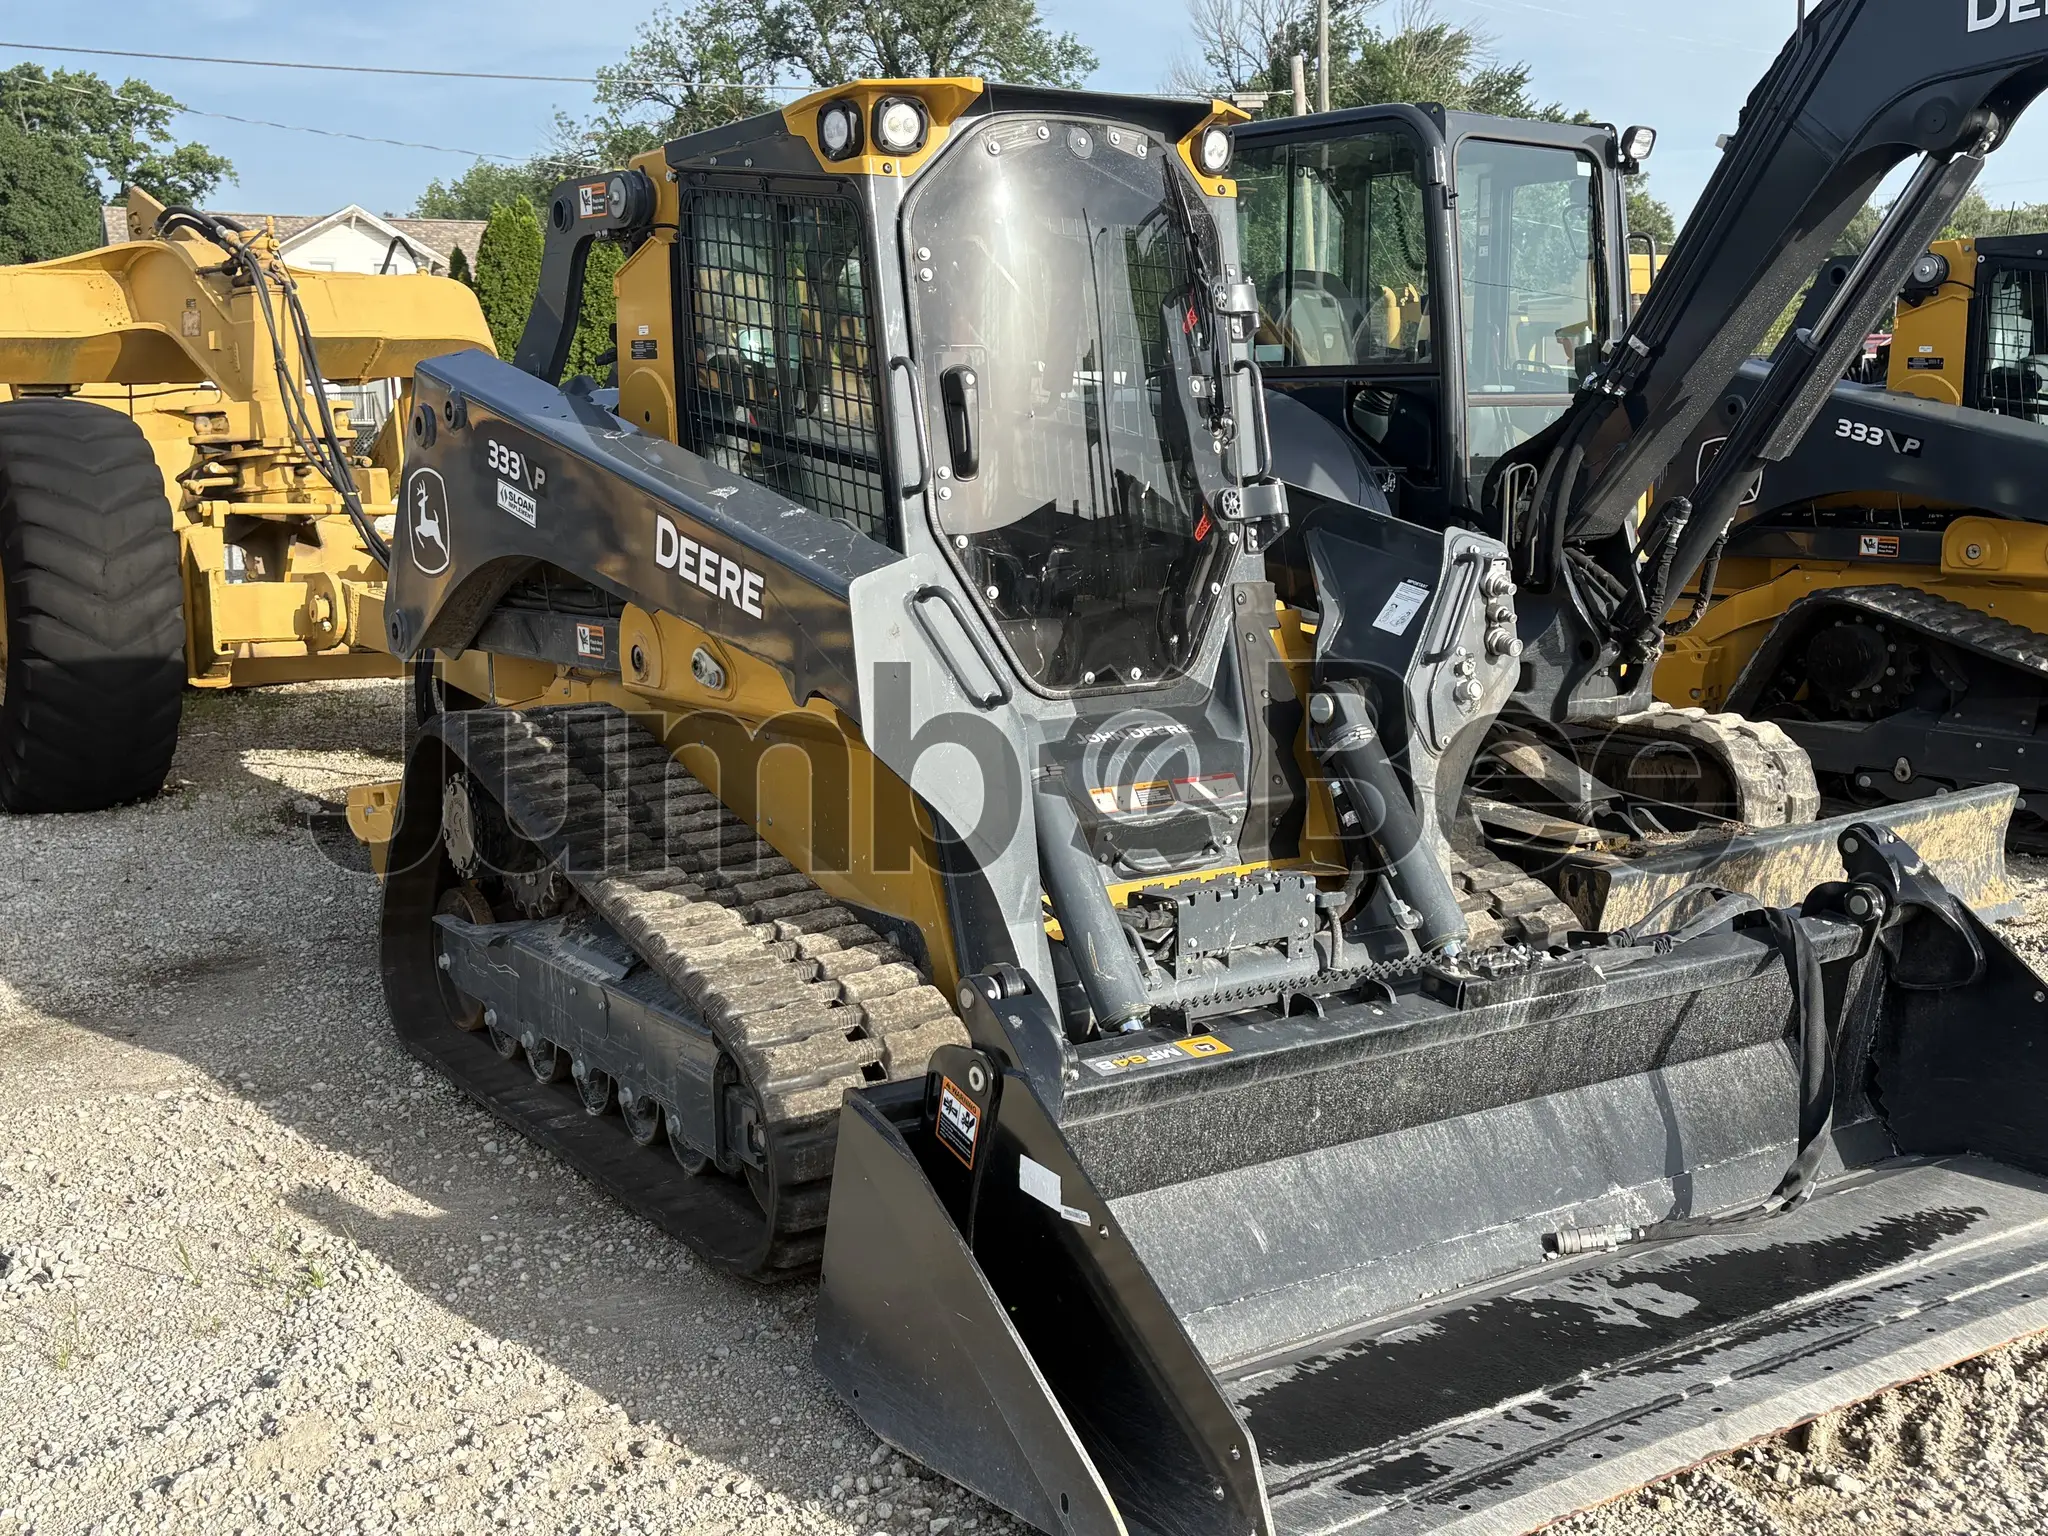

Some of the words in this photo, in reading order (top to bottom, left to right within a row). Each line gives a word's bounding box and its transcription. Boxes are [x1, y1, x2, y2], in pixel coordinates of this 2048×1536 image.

[1967, 0, 2048, 33] DE
[508, 491, 534, 513] SLOAN
[655, 514, 764, 620] DEERE
[1077, 728, 1127, 745] JOHN
[1128, 724, 1193, 740] DEERE
[1095, 1047, 1183, 1071] MP84B
[952, 1088, 977, 1114] WARNING
